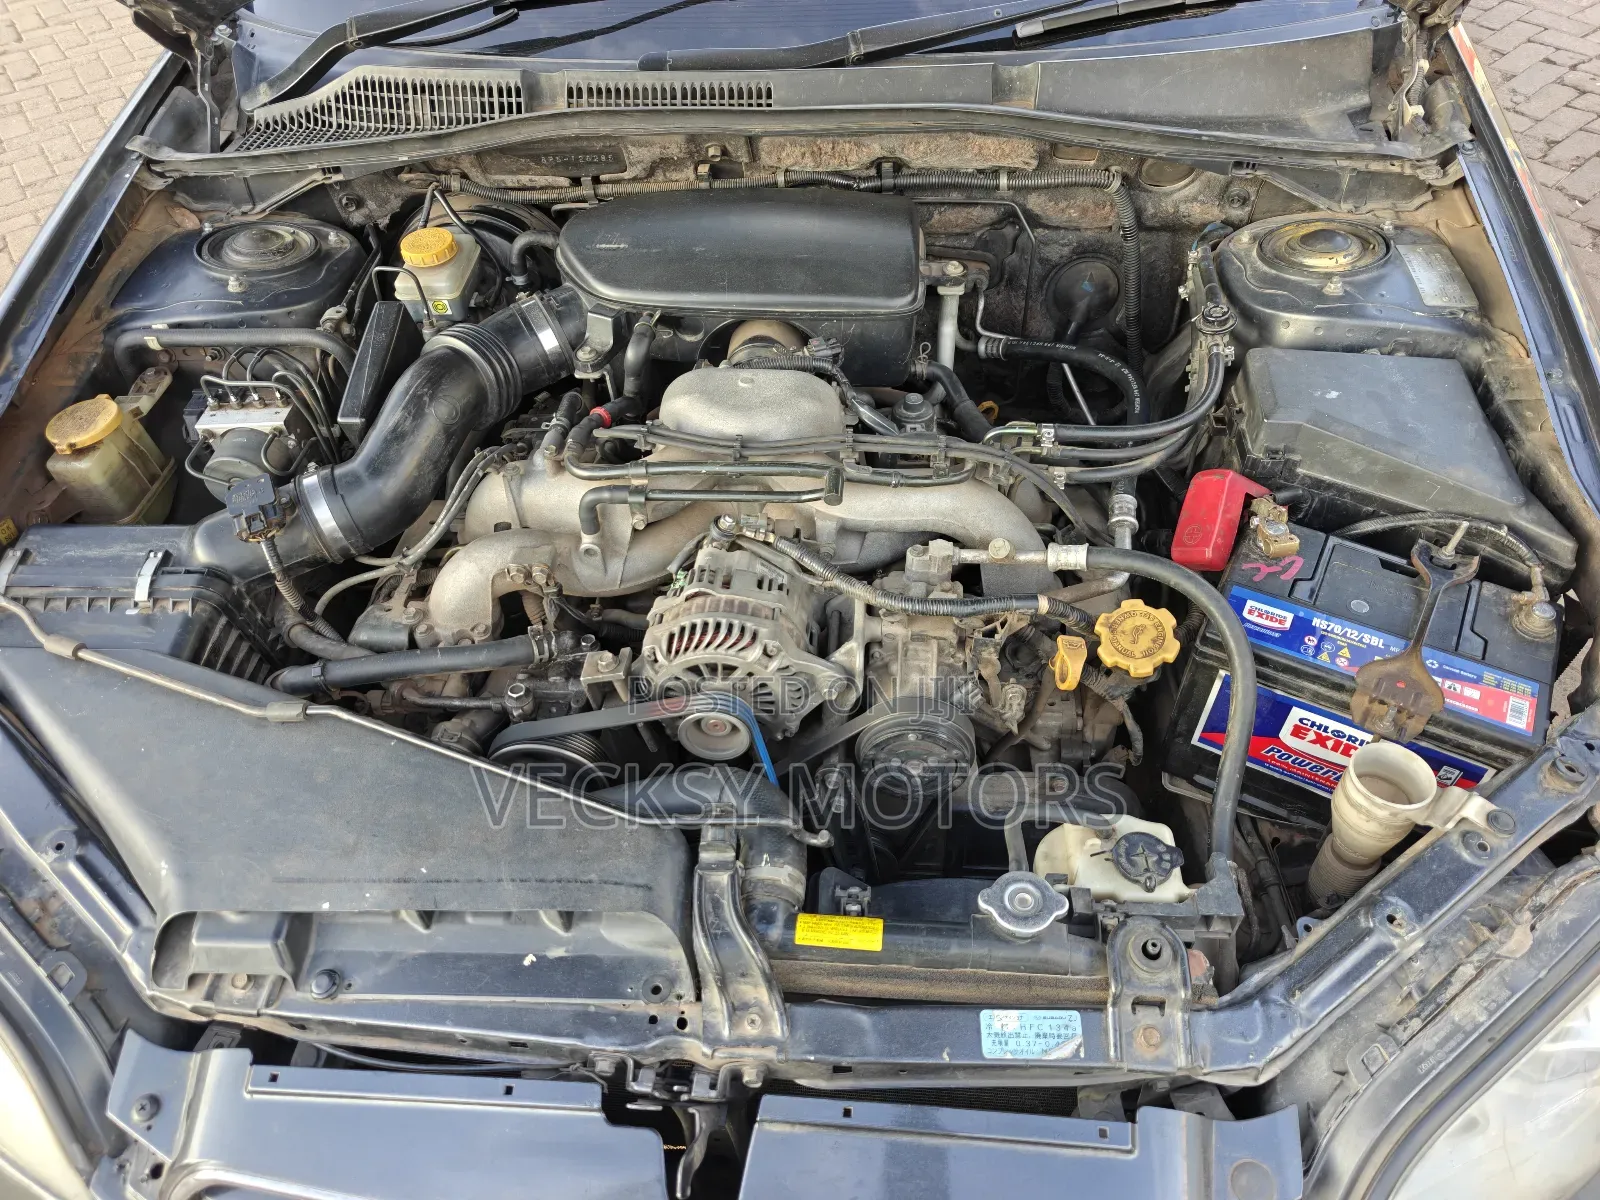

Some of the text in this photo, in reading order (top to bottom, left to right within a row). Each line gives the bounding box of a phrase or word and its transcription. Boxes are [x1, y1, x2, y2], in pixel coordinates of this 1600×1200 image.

[1247, 608, 1288, 626] EXIDE
[1249, 605, 1288, 621] CHLORIDE
[1290, 723, 1359, 758] EXID
[1298, 717, 1370, 748] CHLORI
[1262, 745, 1344, 783] Power
